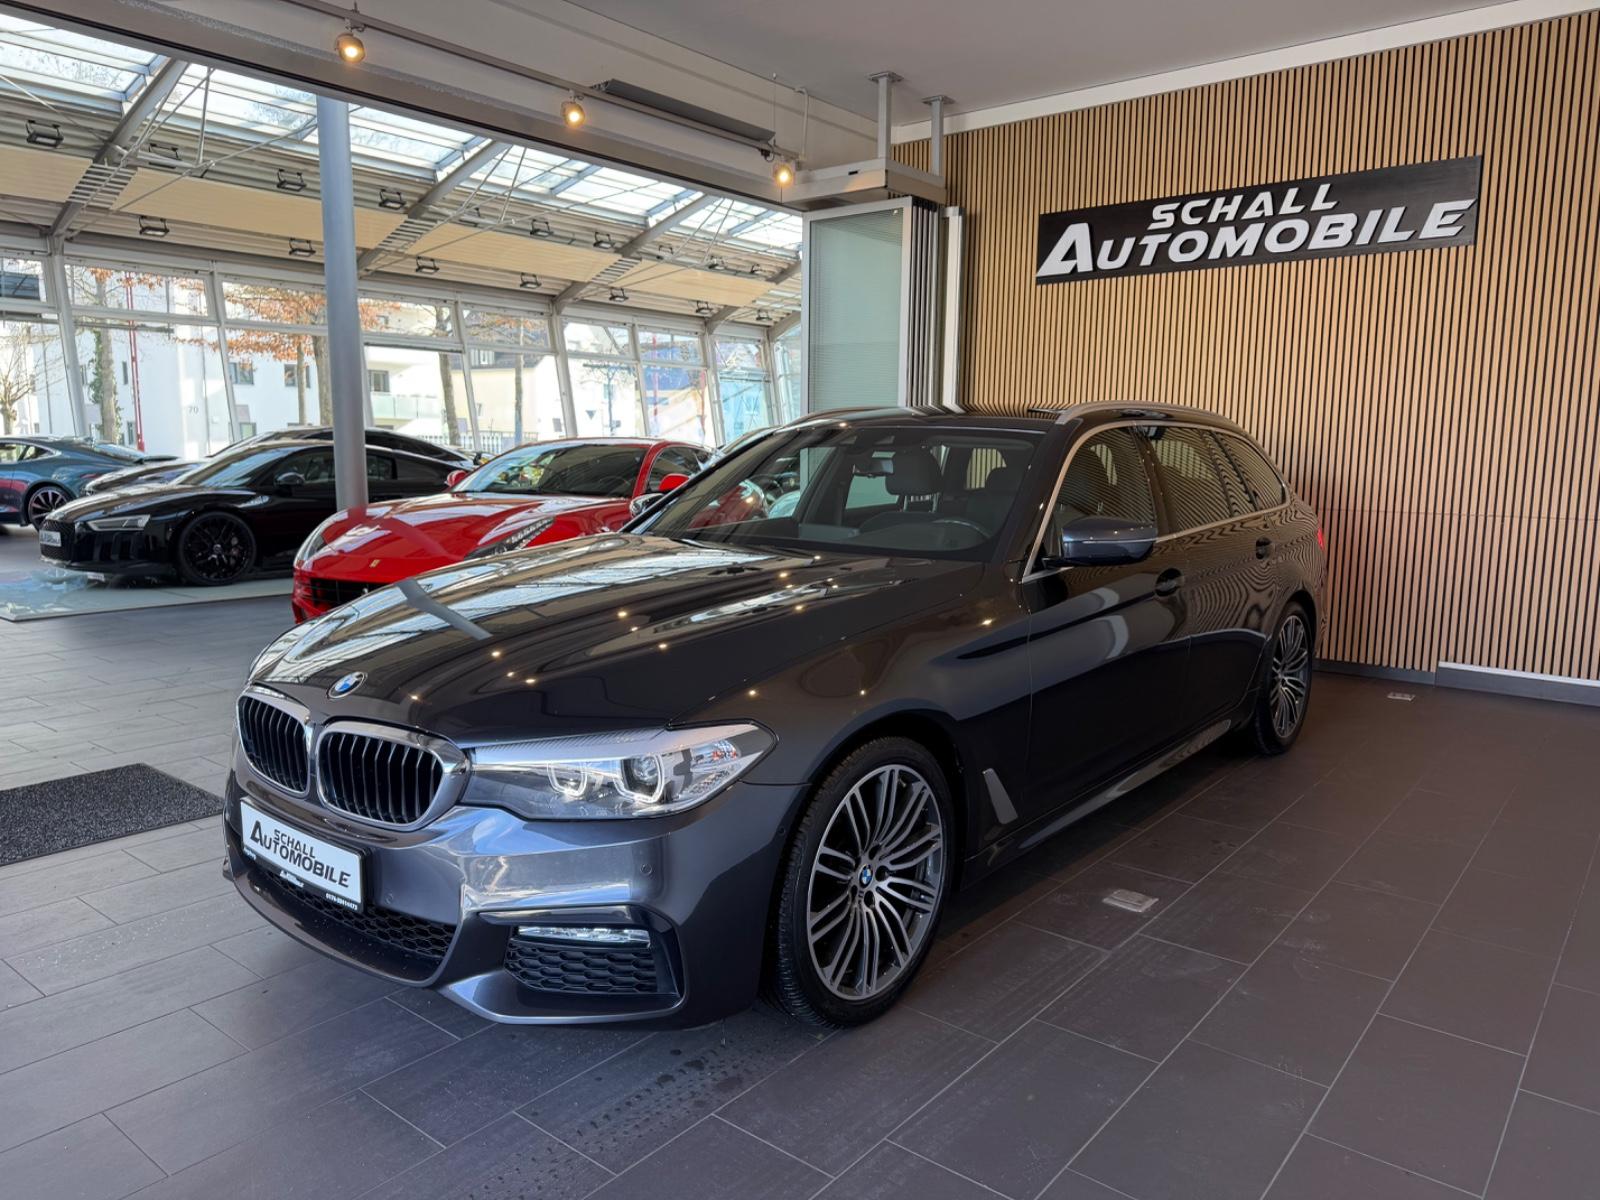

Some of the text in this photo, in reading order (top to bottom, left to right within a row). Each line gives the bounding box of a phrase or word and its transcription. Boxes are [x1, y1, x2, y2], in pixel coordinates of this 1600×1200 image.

[1147, 183, 1339, 230] SCHALL
[1036, 198, 1477, 277] AUTOMOBILE
[250, 820, 351, 887] AUTOMOBILE
[274, 829, 316, 859] SCHALL
